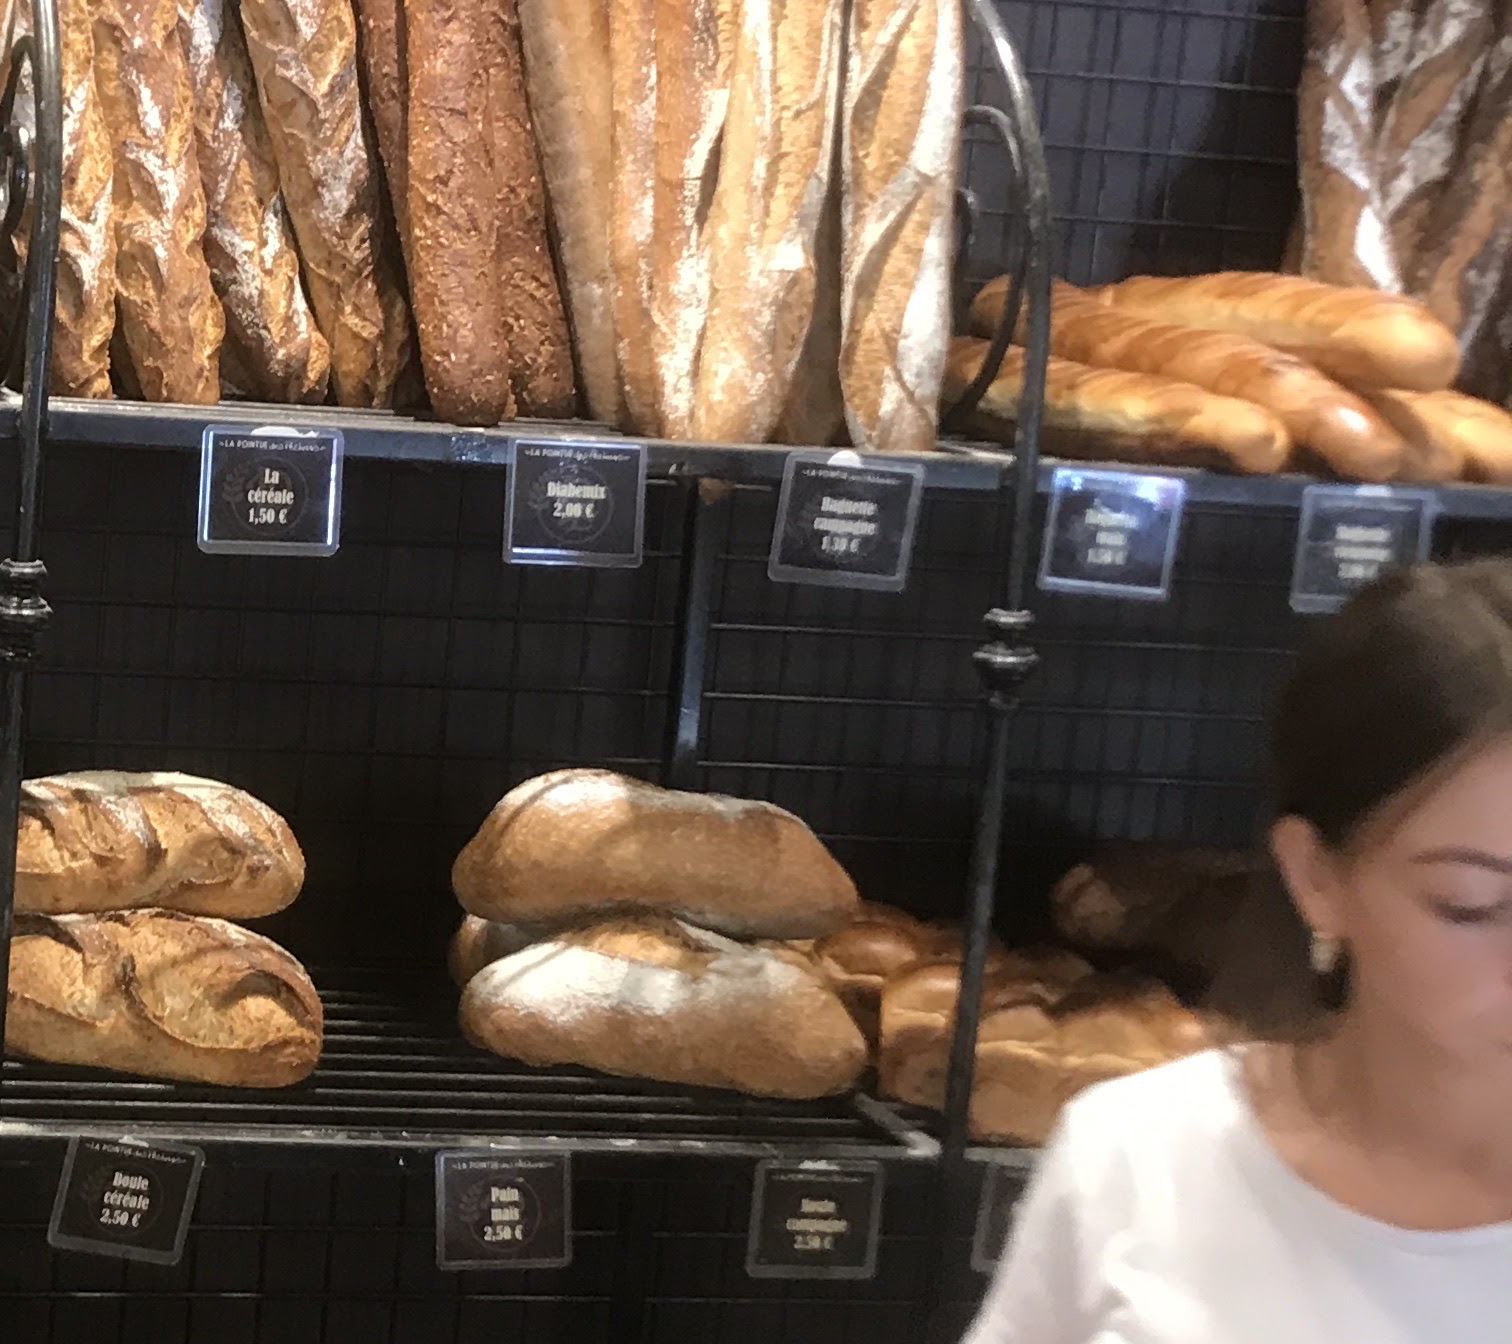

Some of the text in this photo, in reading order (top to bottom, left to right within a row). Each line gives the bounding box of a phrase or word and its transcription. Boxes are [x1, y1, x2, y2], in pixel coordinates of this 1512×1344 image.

[264, 467, 280, 485] La
[247, 487, 295, 505] céréale
[248, 508, 288, 525] 1,50 €
[585, 503, 595, 518] €
[112, 1171, 149, 1191] Boule
[103, 1189, 150, 1210] céréale
[490, 1186, 519, 1203] Pain
[99, 1208, 141, 1228] 2,50 €
[483, 1224, 523, 1242] 2,50 €
